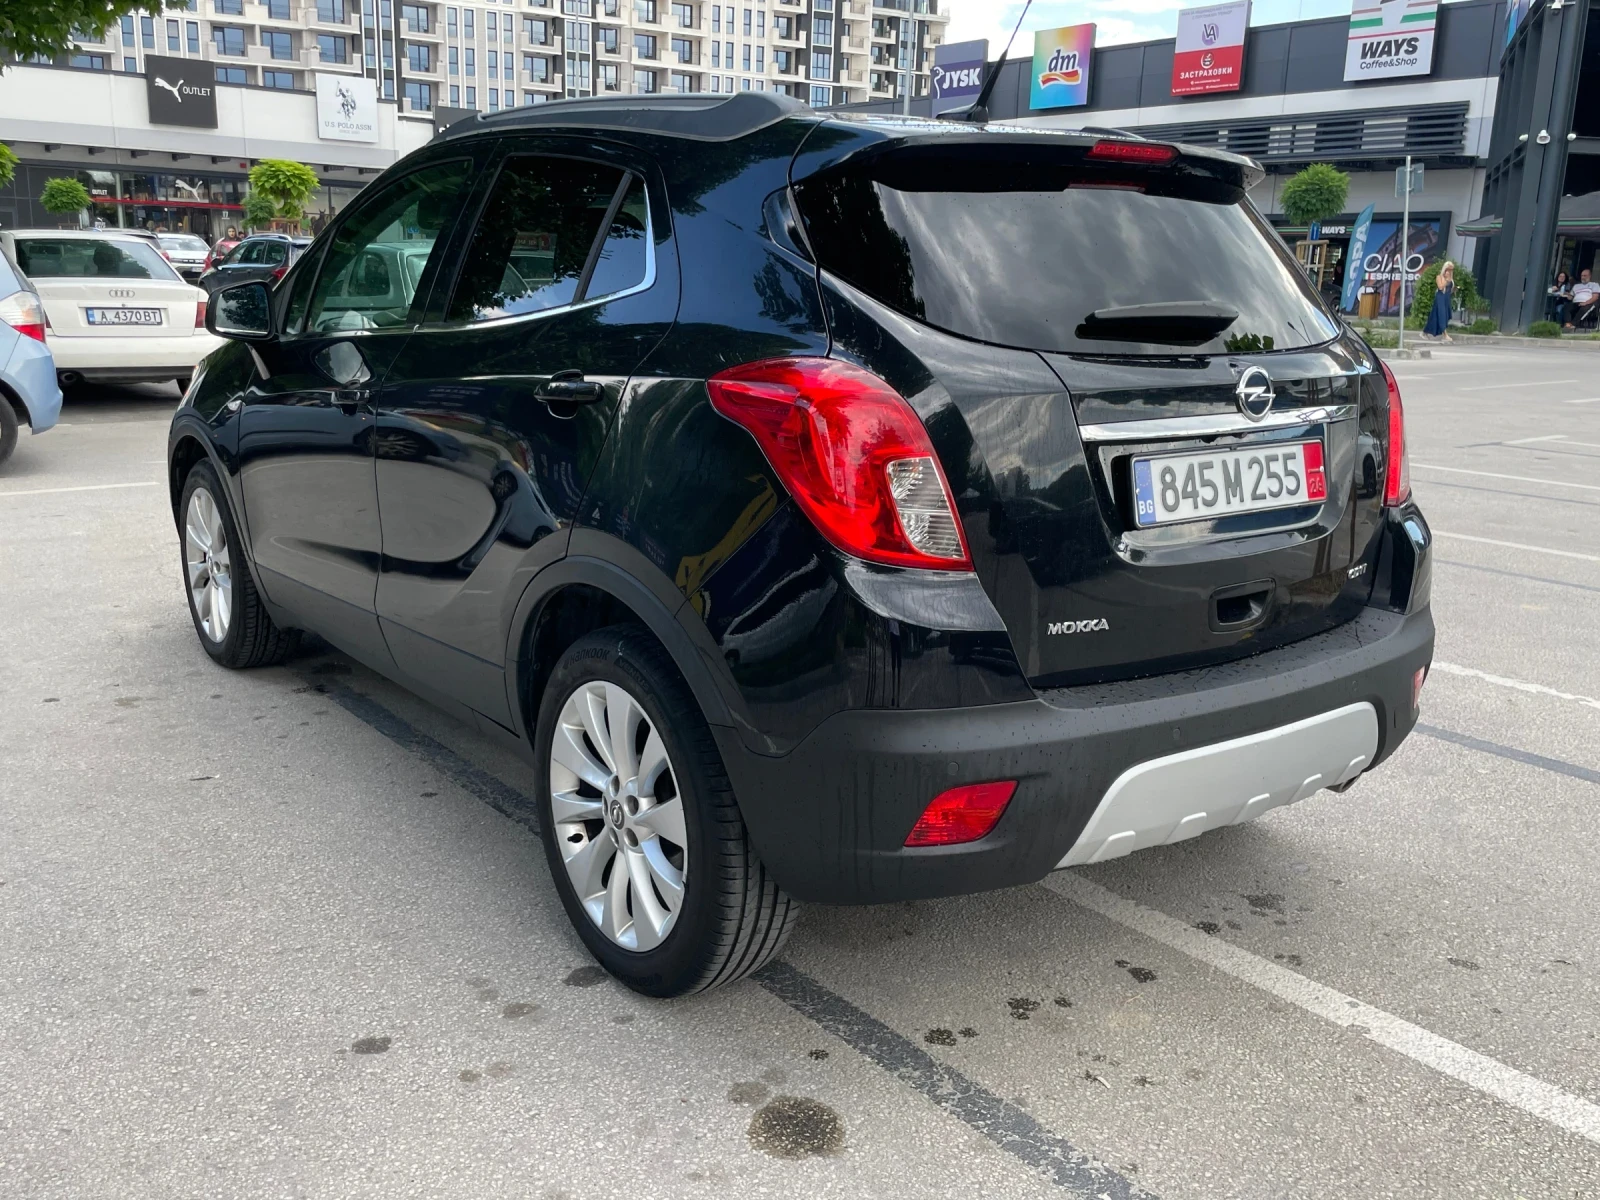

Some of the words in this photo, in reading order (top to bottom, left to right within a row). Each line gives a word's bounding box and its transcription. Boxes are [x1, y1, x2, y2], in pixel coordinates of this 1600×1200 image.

[1360, 36, 1420, 60] WAYS
[1048, 49, 1077, 72] dm
[1360, 57, 1418, 70] Coffee&Shop
[942, 67, 981, 90] JYSK
[1180, 66, 1233, 79] ЗАСТРАХОВКИ
[182, 86, 211, 96] OUTLET
[337, 122, 355, 130] POLO
[1321, 226, 1346, 234] WAYS
[1363, 253, 1425, 273] CIAO
[113, 310, 142, 322] 4370
[1138, 499, 1154, 515] BG
[1047, 618, 1110, 636] MOKKA
